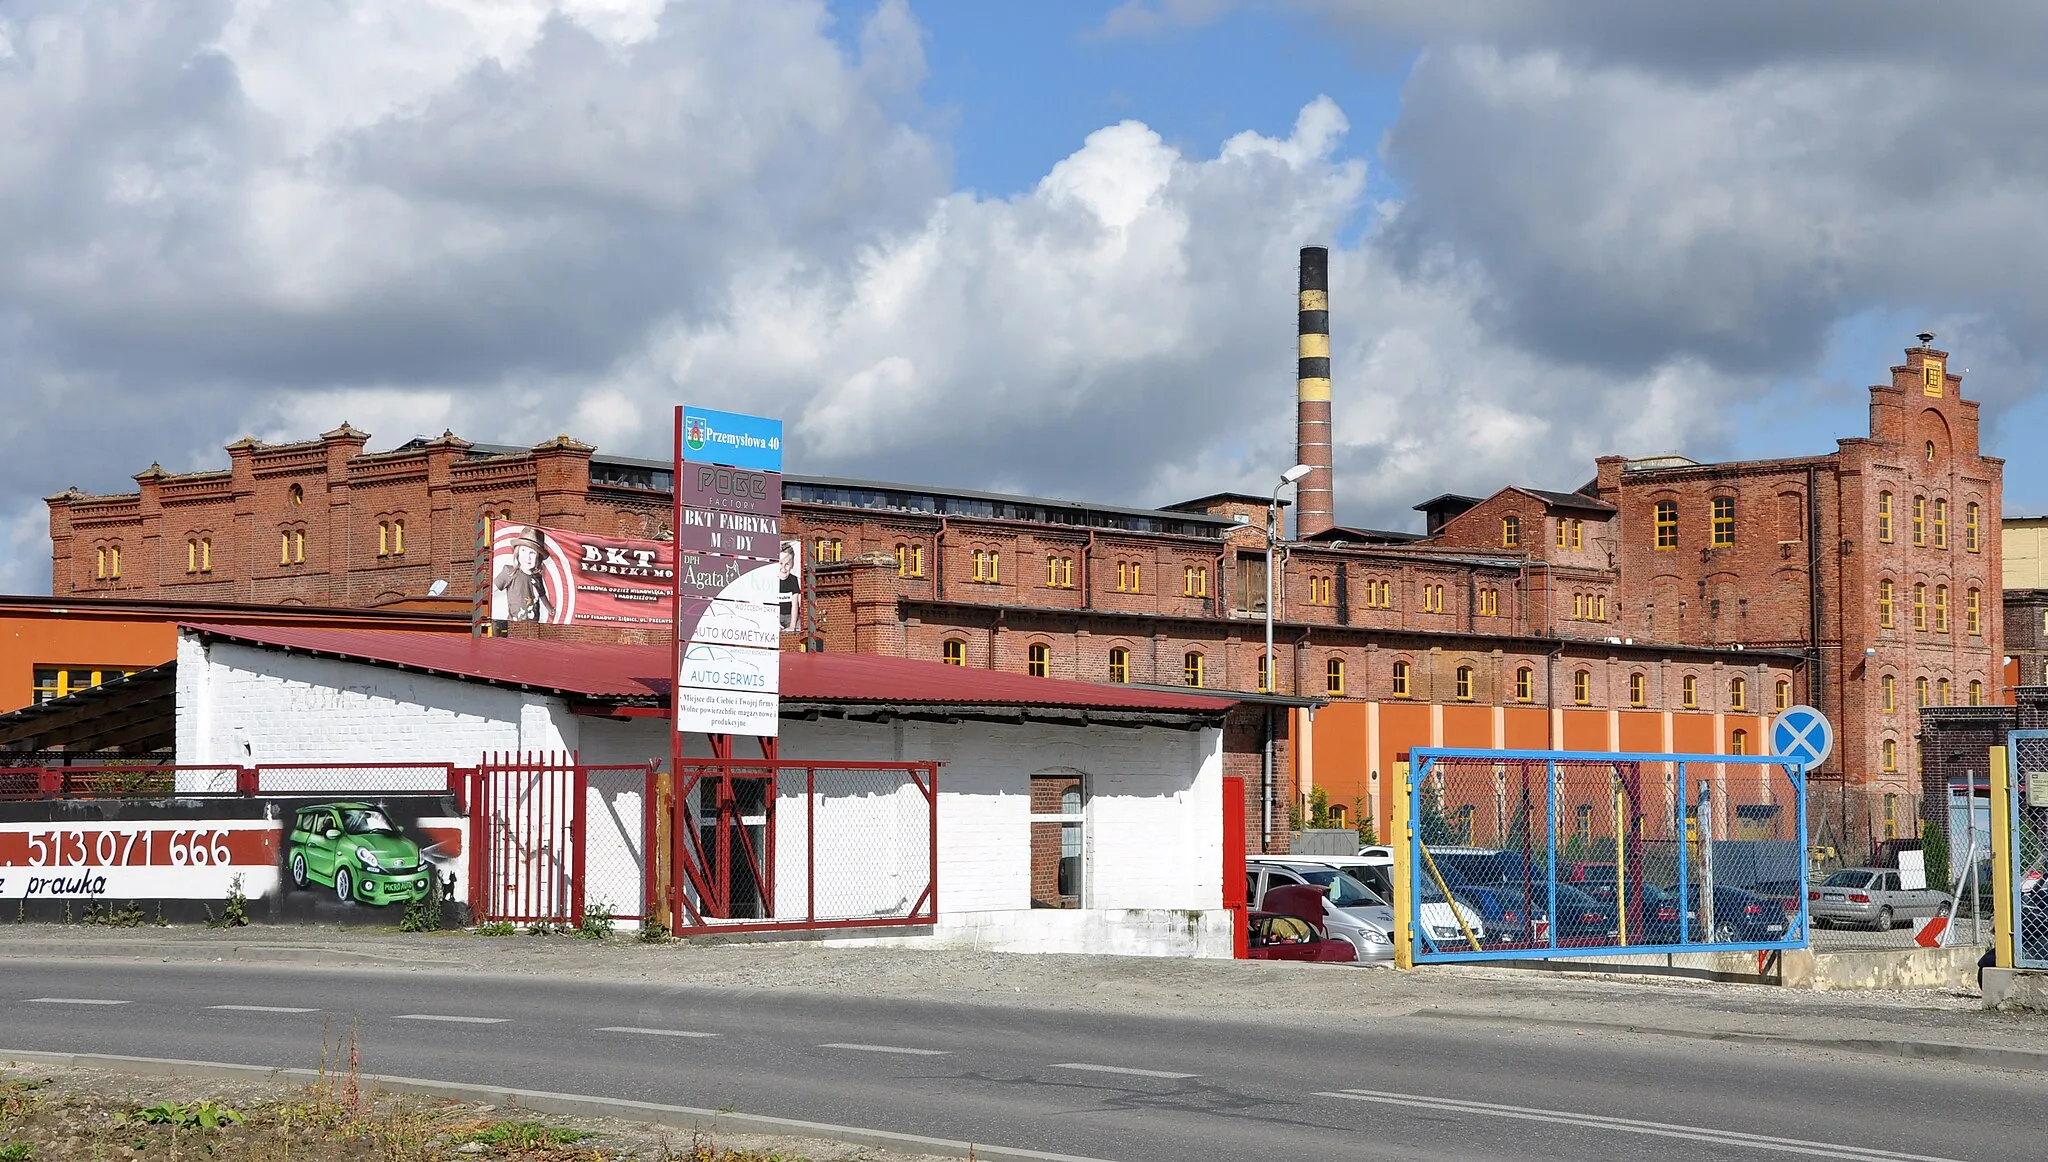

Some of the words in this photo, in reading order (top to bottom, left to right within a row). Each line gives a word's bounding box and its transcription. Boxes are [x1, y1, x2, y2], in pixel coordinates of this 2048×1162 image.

[768, 436, 779, 451] 40
[708, 497, 755, 510] FACTORY
[685, 509, 714, 529] BKT
[719, 513, 777, 535] FABRYKA
[581, 544, 656, 568] BKT
[684, 555, 700, 565] DPH
[581, 562, 648, 577] FABRYKA
[684, 565, 725, 590] Agata
[694, 626, 720, 639] AUTO
[721, 628, 776, 643] KOSMETYKA
[690, 670, 721, 684] AUTO
[723, 672, 765, 687] SERWIS
[683, 694, 705, 704] Miejsce
[706, 696, 715, 704] dla
[716, 696, 733, 705] Ciebie
[739, 698, 758, 708] Twojej
[758, 699, 774, 709] firmy
[680, 705, 699, 713] Wolne
[738, 710, 773, 719] magazynowe
[711, 718, 746, 728] produkcyjne
[28, 829, 88, 867] 513
[95, 829, 153, 867] 071
[169, 829, 231, 867] 666
[24, 868, 107, 899] prawka
[384, 883, 400, 892] MICRO
